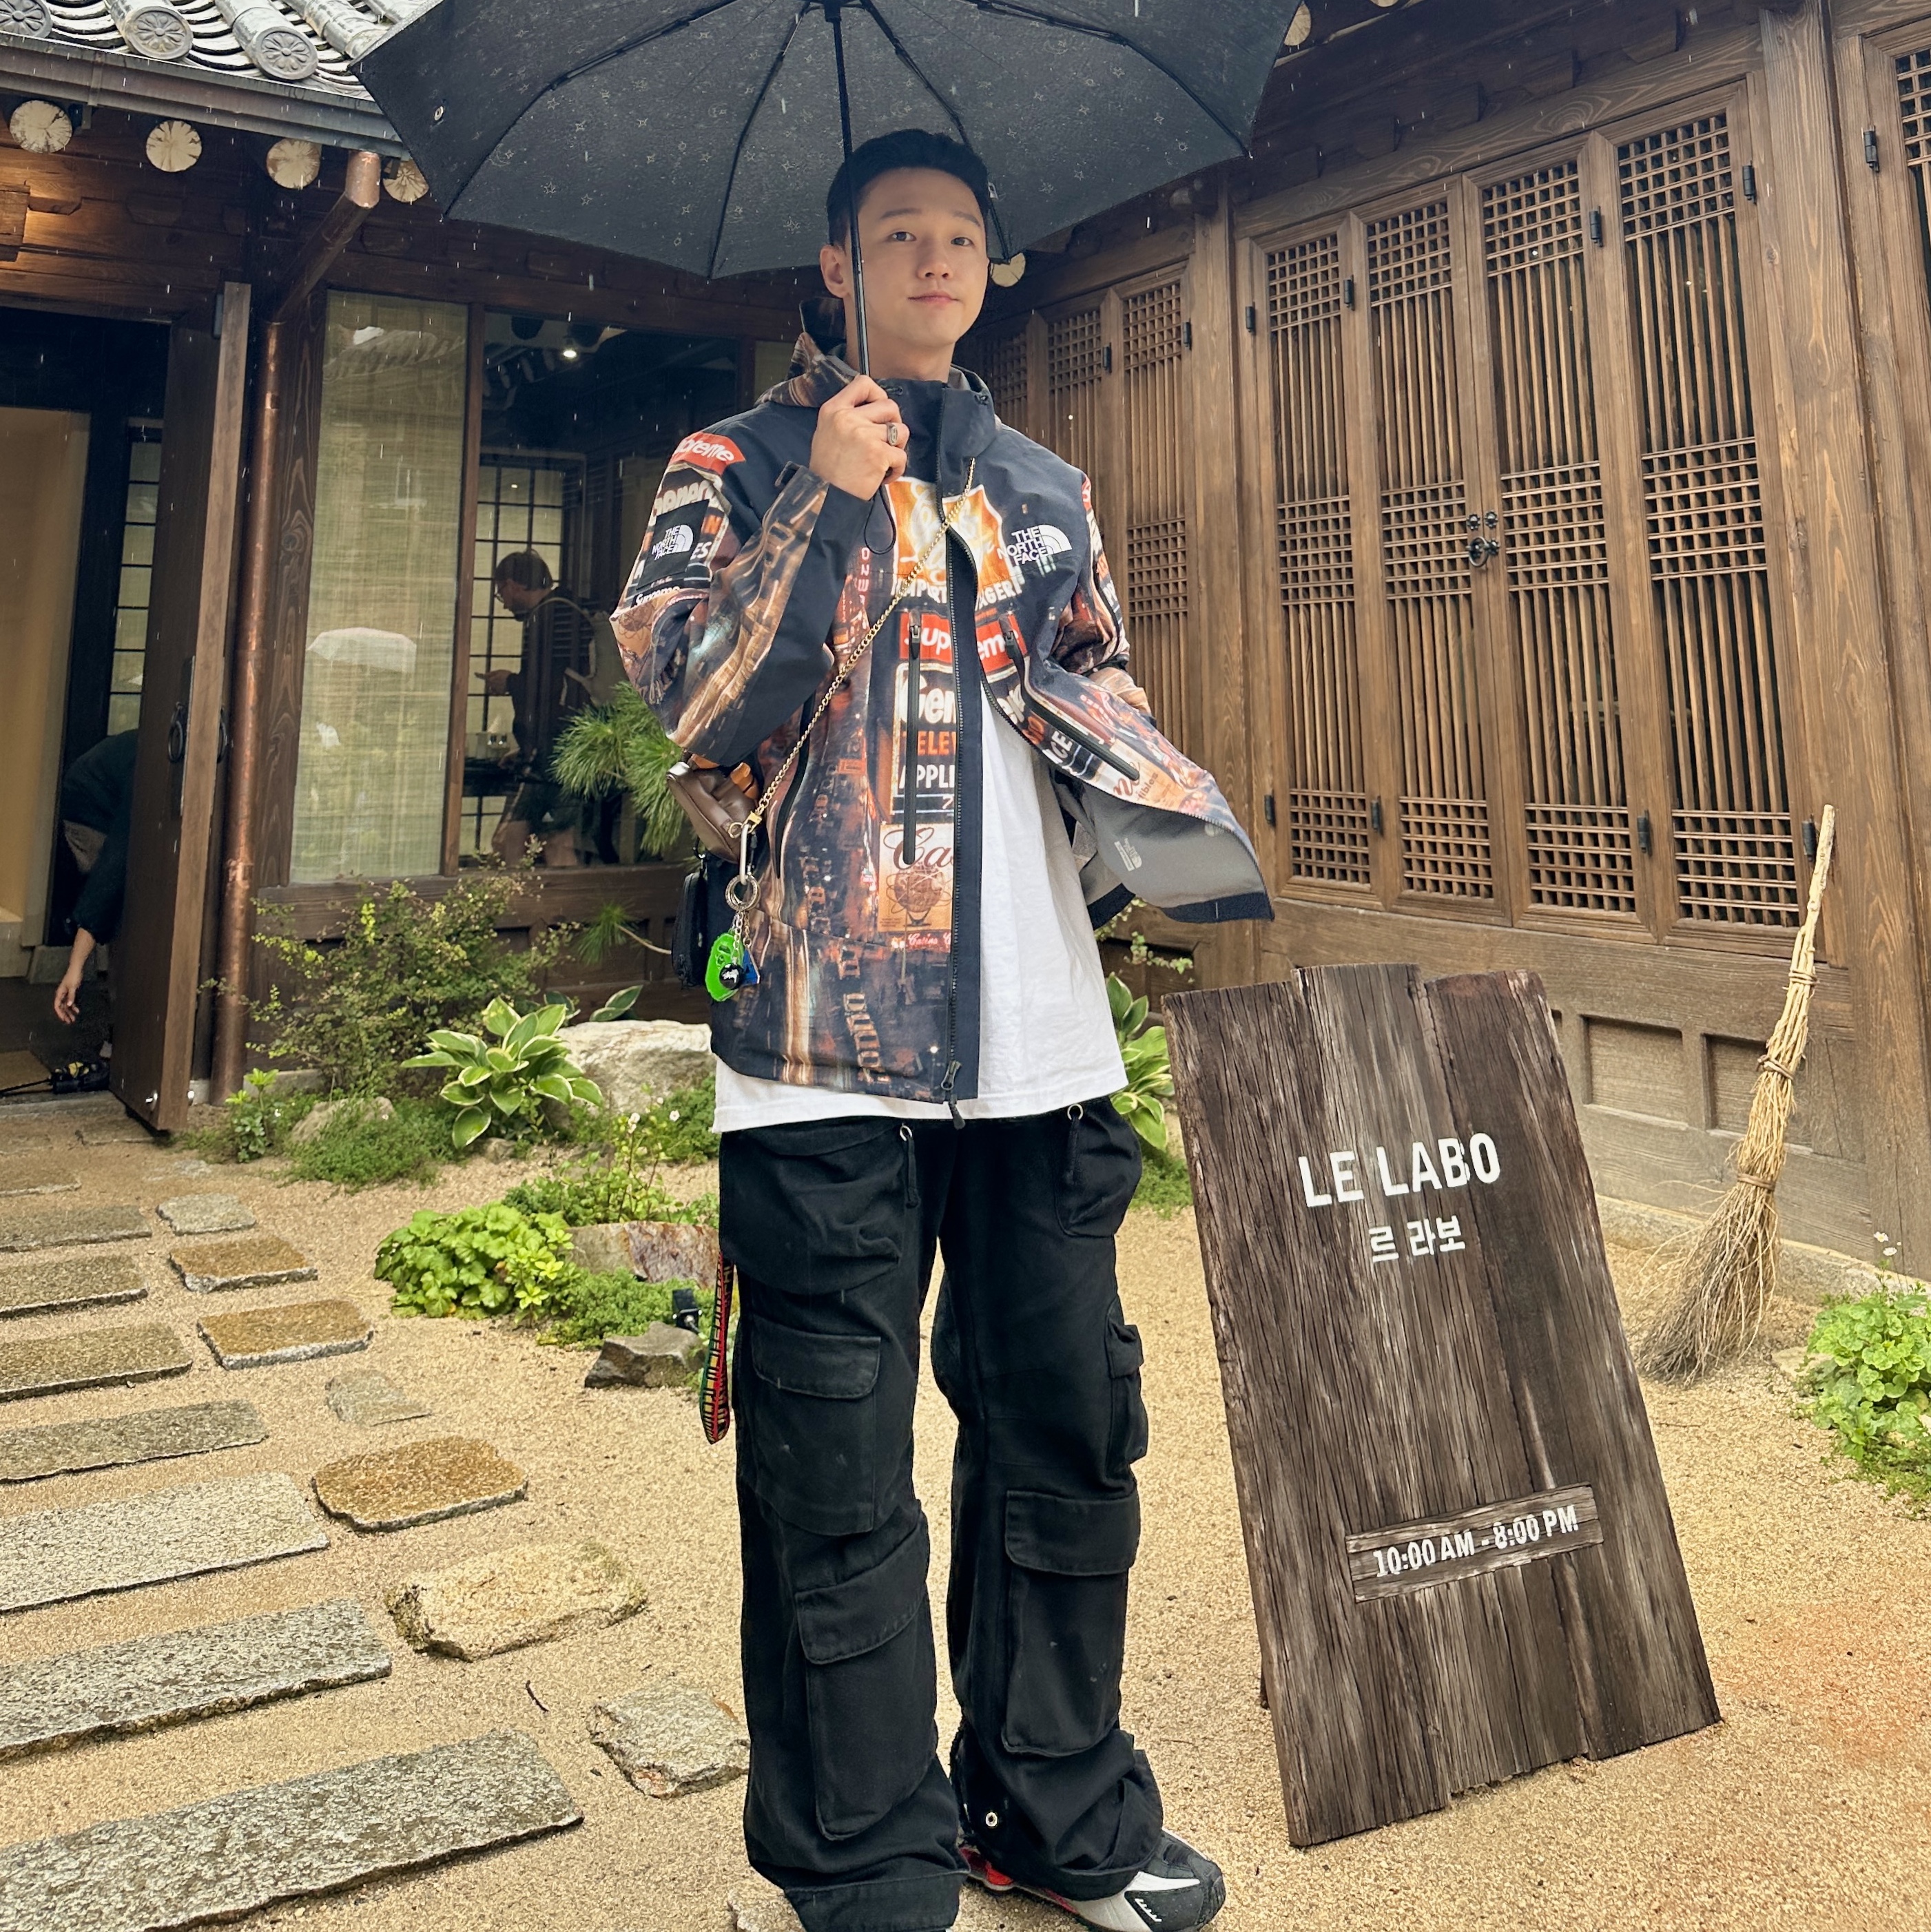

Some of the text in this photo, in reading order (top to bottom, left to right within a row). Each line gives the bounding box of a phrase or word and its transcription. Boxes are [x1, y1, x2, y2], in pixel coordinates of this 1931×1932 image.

[665, 525, 681, 539] THE
[1011, 526, 1041, 543] THE
[652, 535, 678, 555] NORTH
[997, 537, 1045, 559] NORTH
[1013, 546, 1049, 566] FACE
[1299, 1133, 1500, 1207] LE LABO
[1369, 1216, 1466, 1263] 르 라보
[1373, 1539, 1436, 1577] 10:00
[1440, 1529, 1475, 1561] AM
[1493, 1514, 1540, 1550] 8:00
[1542, 1504, 1579, 1537] PM
